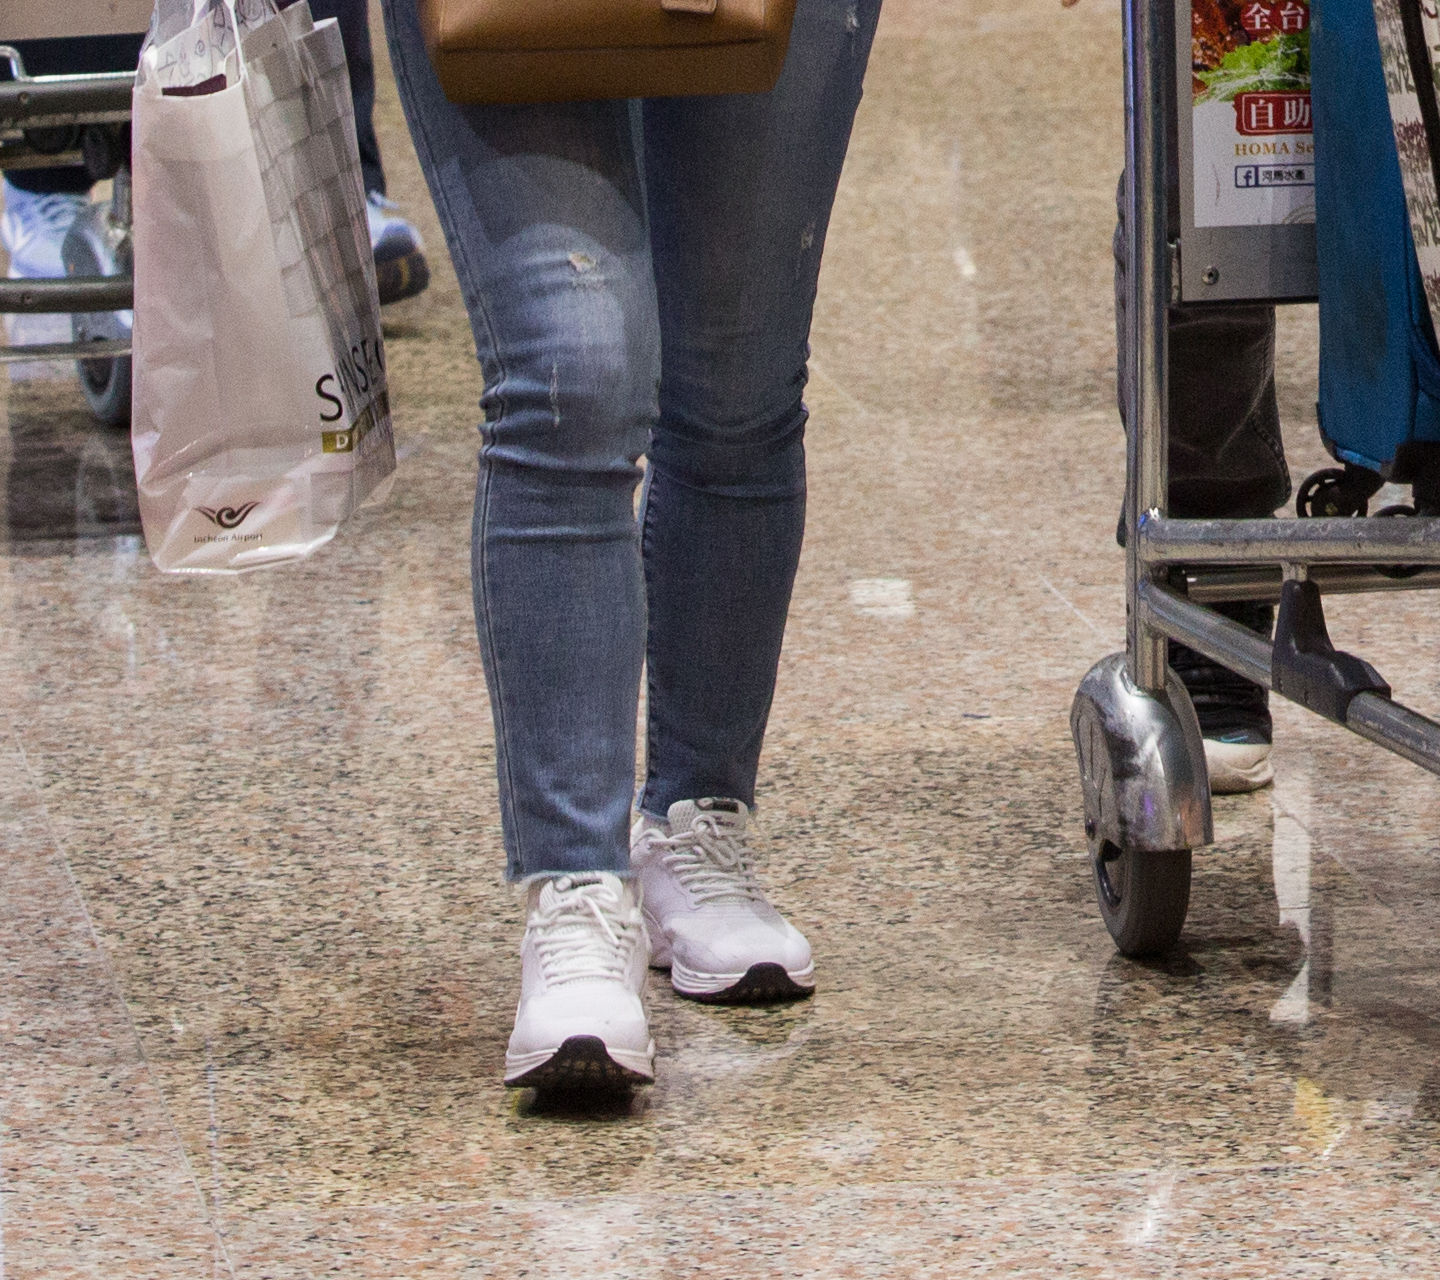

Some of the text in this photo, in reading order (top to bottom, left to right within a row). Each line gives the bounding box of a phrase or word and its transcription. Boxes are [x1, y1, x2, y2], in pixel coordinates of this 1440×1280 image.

[1234, 142, 1290, 157] HOMA
[193, 532, 263, 544] Incheon Airport
